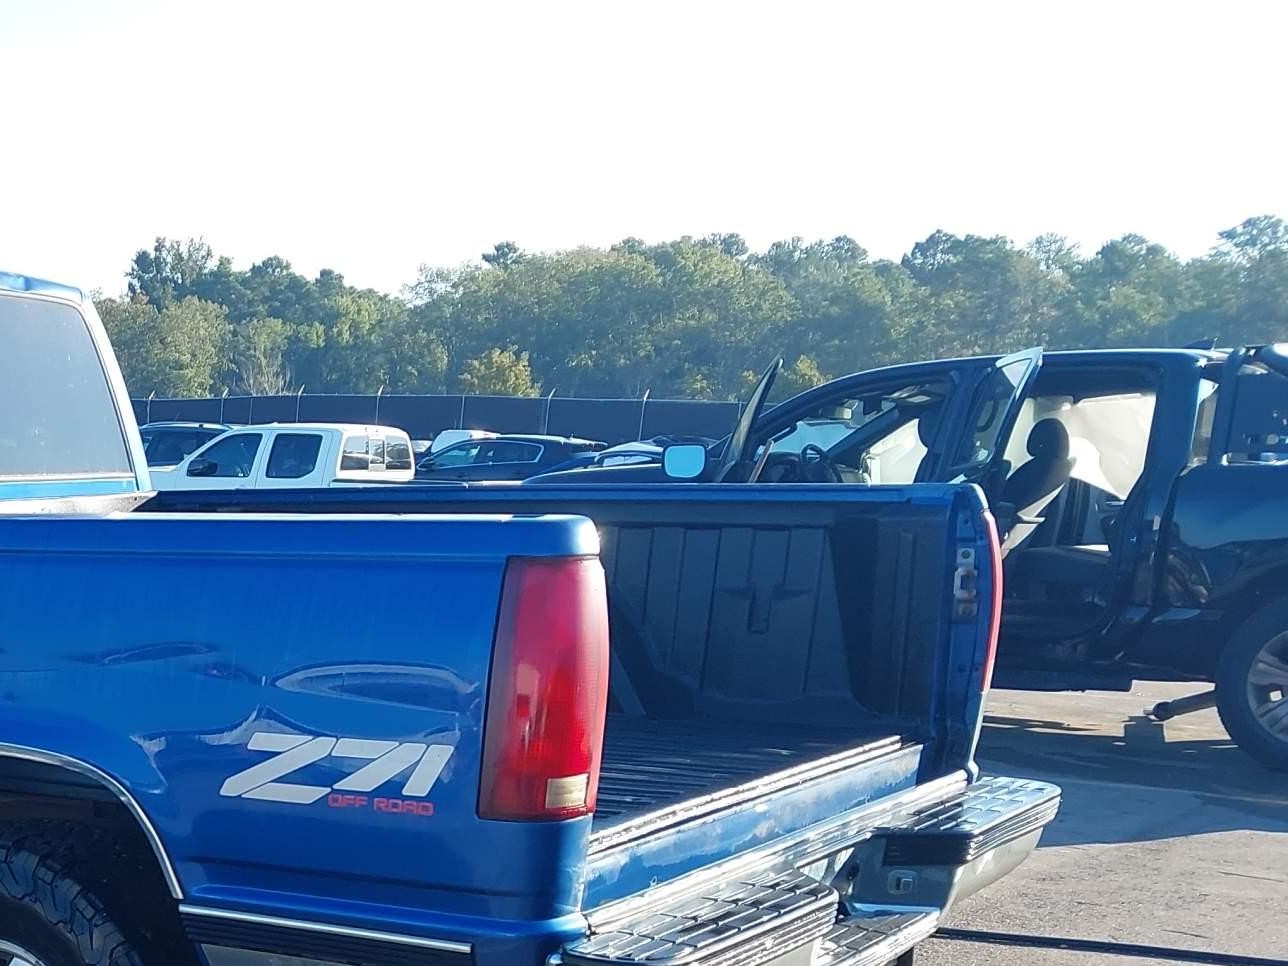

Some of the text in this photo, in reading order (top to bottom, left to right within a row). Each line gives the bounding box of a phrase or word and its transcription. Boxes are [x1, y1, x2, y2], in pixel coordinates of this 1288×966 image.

[219, 732, 455, 804] Z71
[328, 793, 434, 816] OFF ROAD
